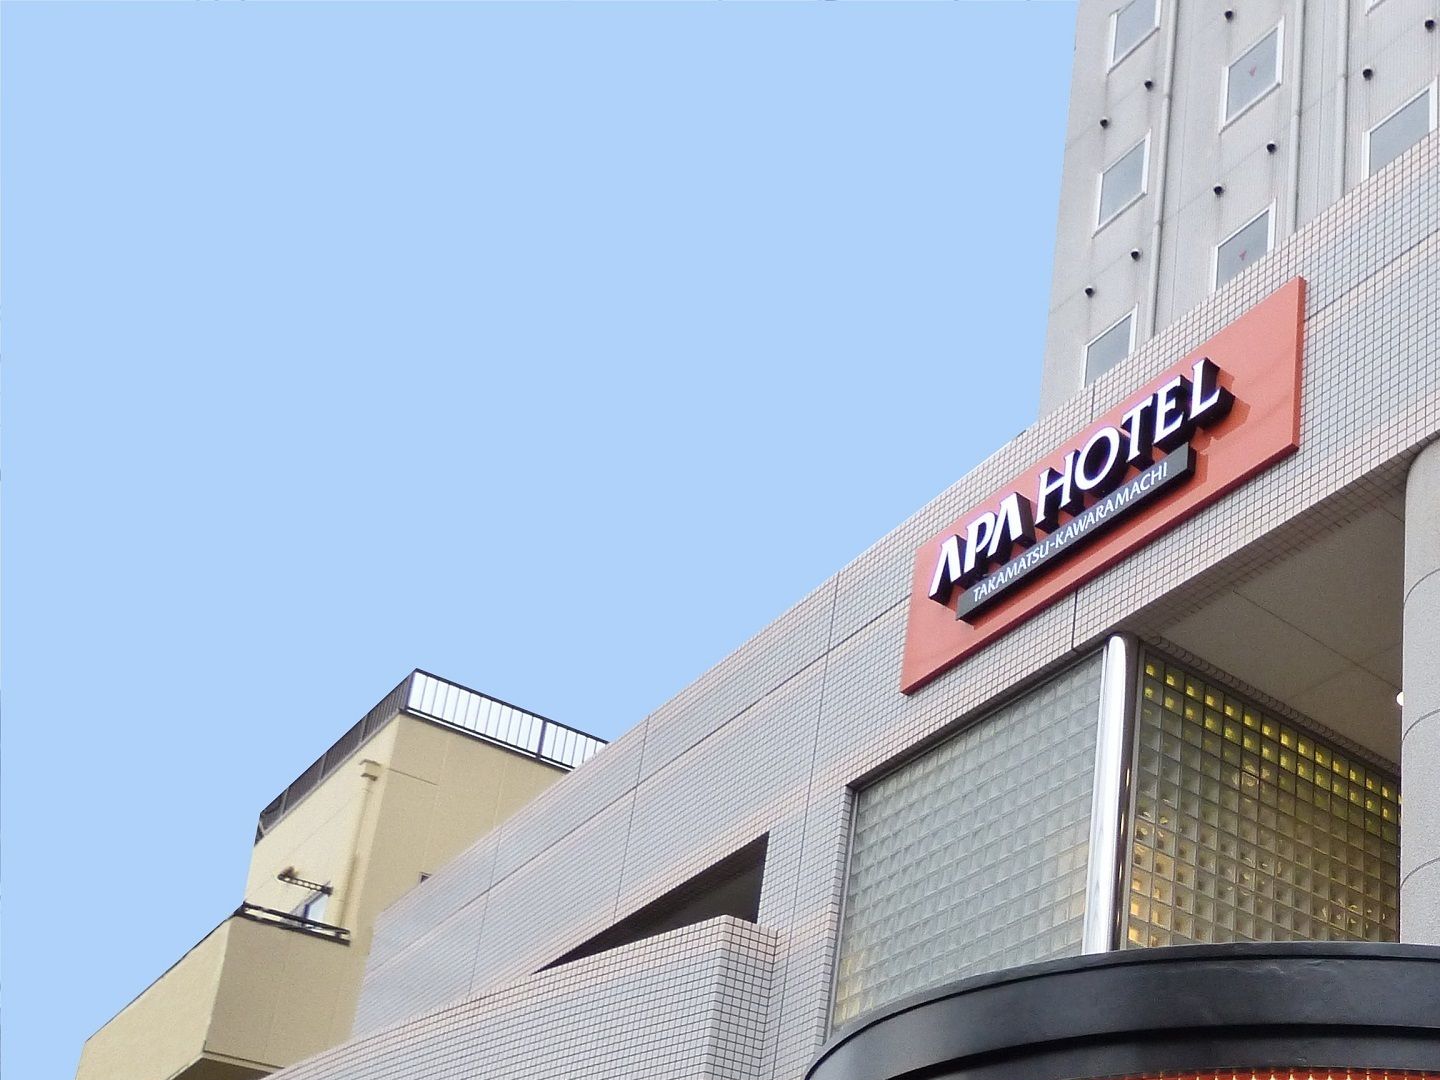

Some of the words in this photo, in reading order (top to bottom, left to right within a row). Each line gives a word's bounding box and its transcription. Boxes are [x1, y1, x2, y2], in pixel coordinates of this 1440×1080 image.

[928, 491, 1026, 599] APA
[1034, 357, 1226, 526] HOTEL
[972, 460, 1168, 602] TAKAMATSU-KAWARAMACHI
